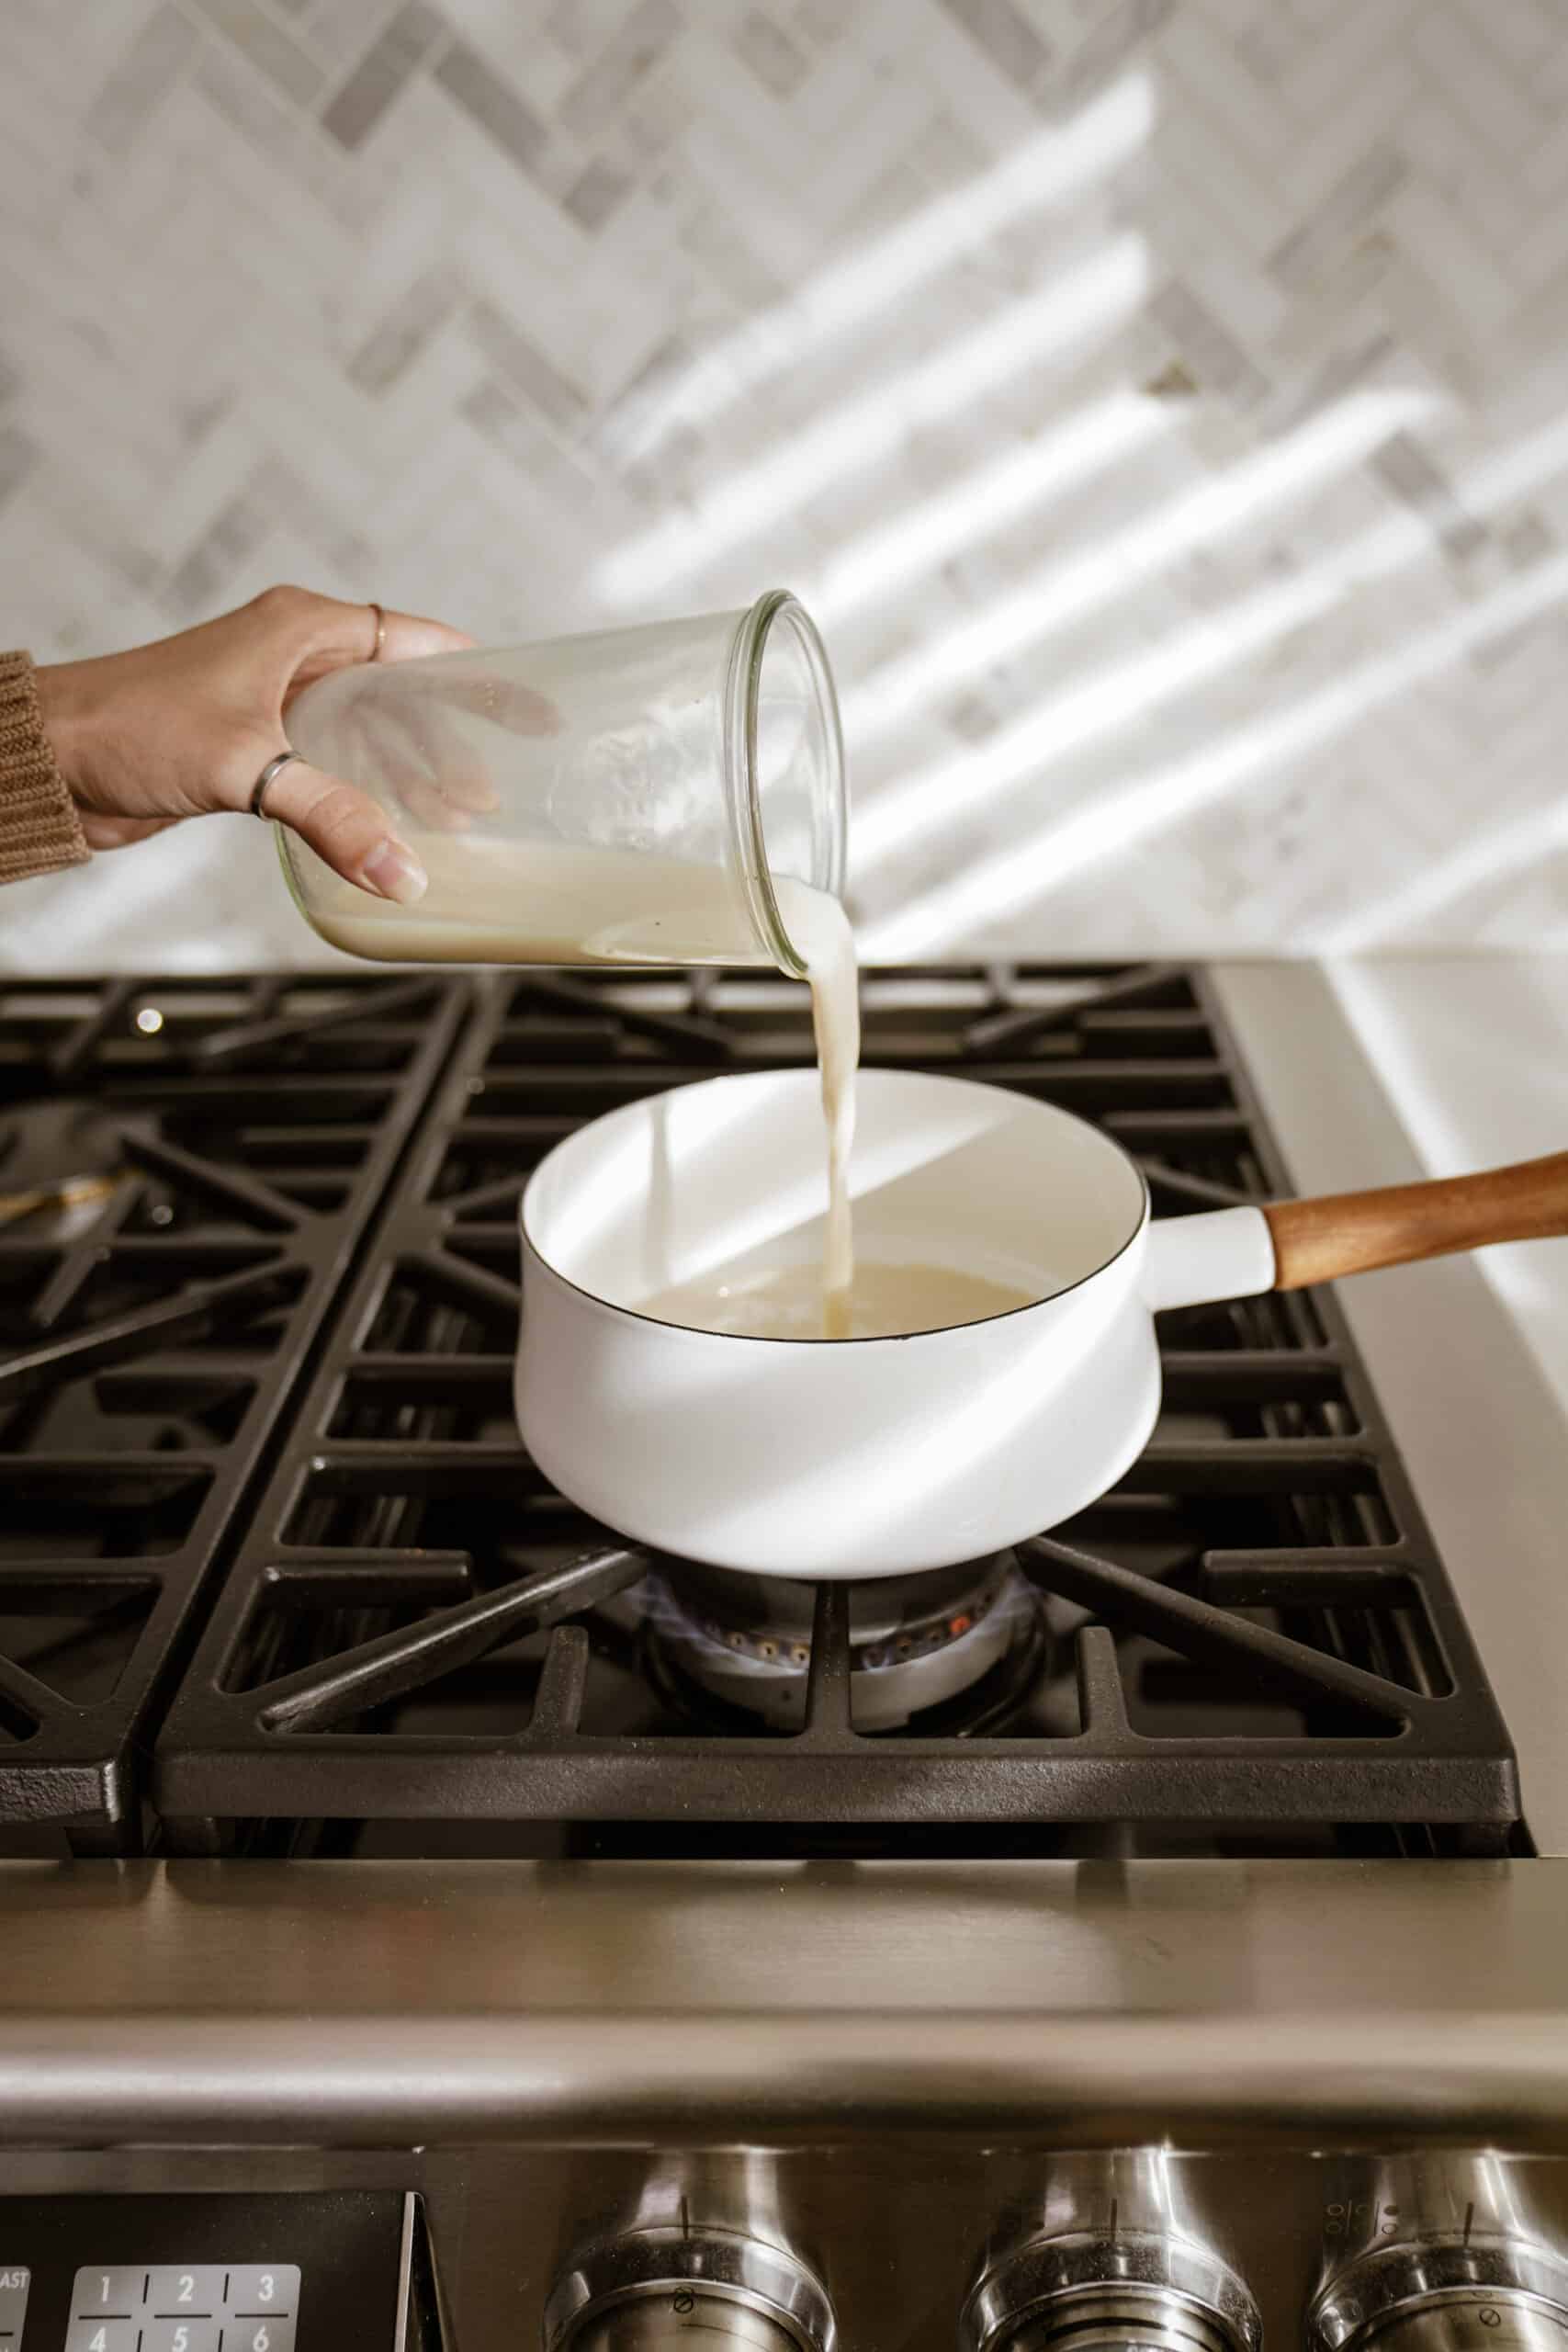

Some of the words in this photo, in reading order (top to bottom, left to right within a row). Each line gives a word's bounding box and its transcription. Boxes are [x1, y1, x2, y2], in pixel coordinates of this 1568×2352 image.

[101, 2276, 110, 2302] 1
[177, 2275, 194, 2301] 2
[258, 2274, 274, 2301] 3
[88, 2326, 107, 2352] 4
[172, 2326, 188, 2352] 5
[253, 2324, 269, 2352] 6
